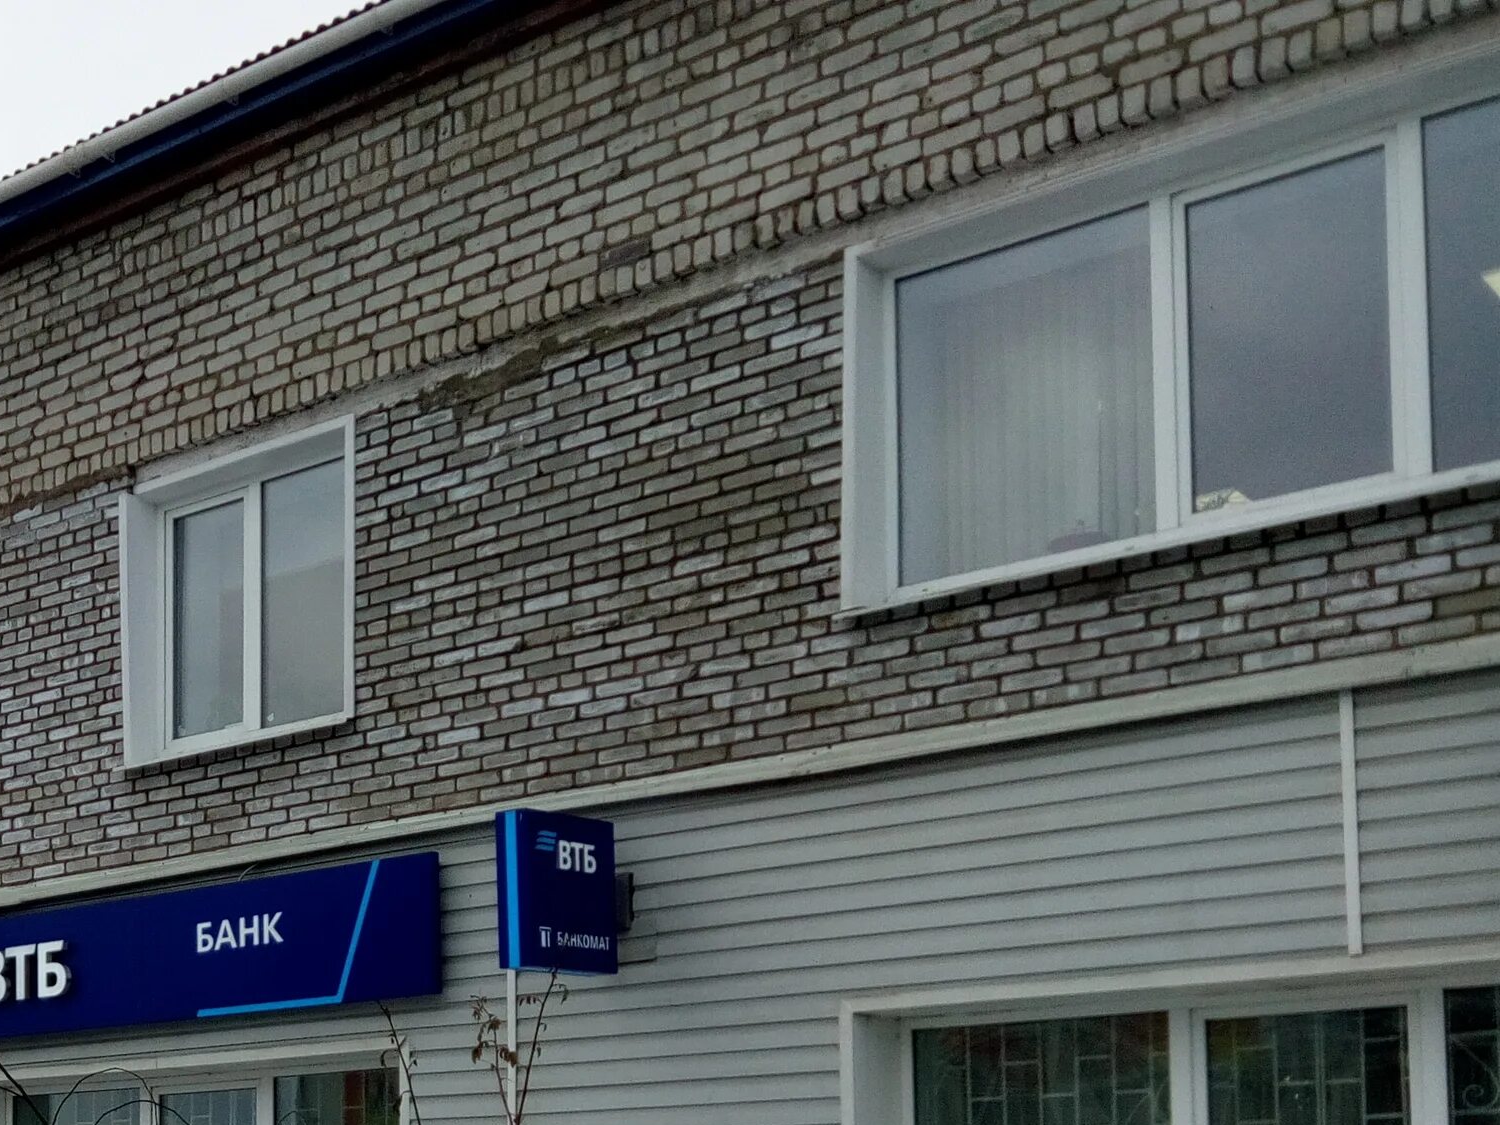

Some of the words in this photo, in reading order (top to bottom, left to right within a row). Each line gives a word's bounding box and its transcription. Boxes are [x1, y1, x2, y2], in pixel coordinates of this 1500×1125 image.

[558, 839, 597, 874] ВТБ
[196, 911, 285, 953] БАНК
[557, 931, 610, 951] БАНКОМАТ
